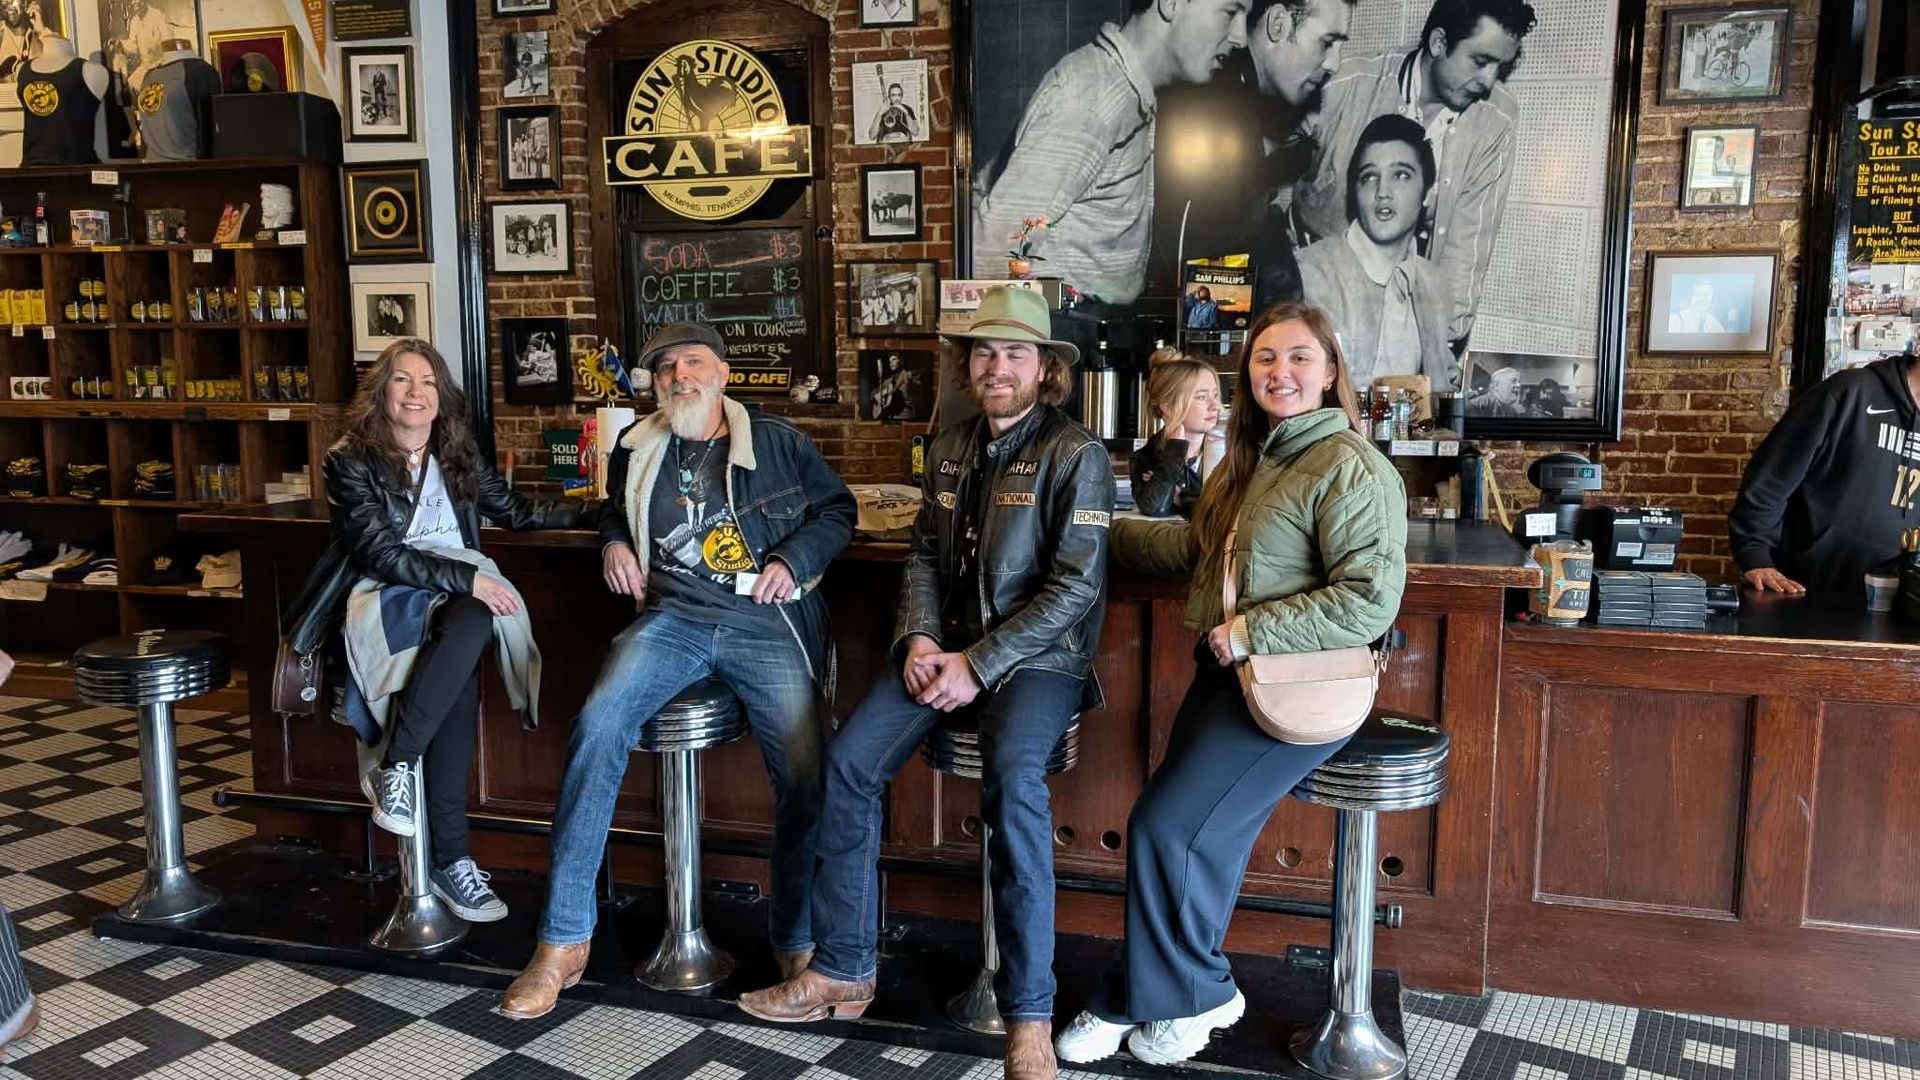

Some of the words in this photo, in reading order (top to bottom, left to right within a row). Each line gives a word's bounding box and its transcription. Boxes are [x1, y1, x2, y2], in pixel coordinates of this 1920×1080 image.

[631, 66, 673, 131] SUN
[695, 46, 780, 122] STUDIO
[1859, 123, 1892, 140] Sun
[1869, 142, 1900, 157] Tour
[1907, 141, 1920, 155] R
[616, 134, 798, 178] CAFE
[1858, 163, 1870, 173] No
[1873, 163, 1900, 172] Drinks
[1857, 174, 1869, 184] No
[1872, 174, 1908, 183] Children
[1856, 185, 1868, 195] No
[1871, 185, 1894, 194] Flash
[662, 189, 704, 212] MEMPHIS,
[706, 186, 756, 212] TENNESSEE
[1870, 198, 1880, 206] or
[1882, 195, 1914, 207] Filming
[1892, 211, 1912, 222] BUT
[1853, 225, 1893, 236] Laughter,
[1856, 237, 1863, 248] A
[644, 239, 712, 272] SODA
[770, 232, 801, 258] $3
[1874, 248, 1890, 257] Are
[641, 271, 743, 302] COFFEE
[773, 267, 801, 293] $3
[1195, 274, 1212, 282] SAM
[1213, 275, 1245, 284] PHILLIPS
[640, 303, 709, 323] WATER
[725, 324, 745, 337] ON
[752, 322, 784, 336] TOUR
[728, 373, 745, 384] IO
[749, 373, 788, 384] CAFE
[551, 443, 579, 454] SOLD
[553, 455, 578, 465] HERE
[1641, 515, 1673, 525] DOPE
[714, 557, 751, 570] Studio
